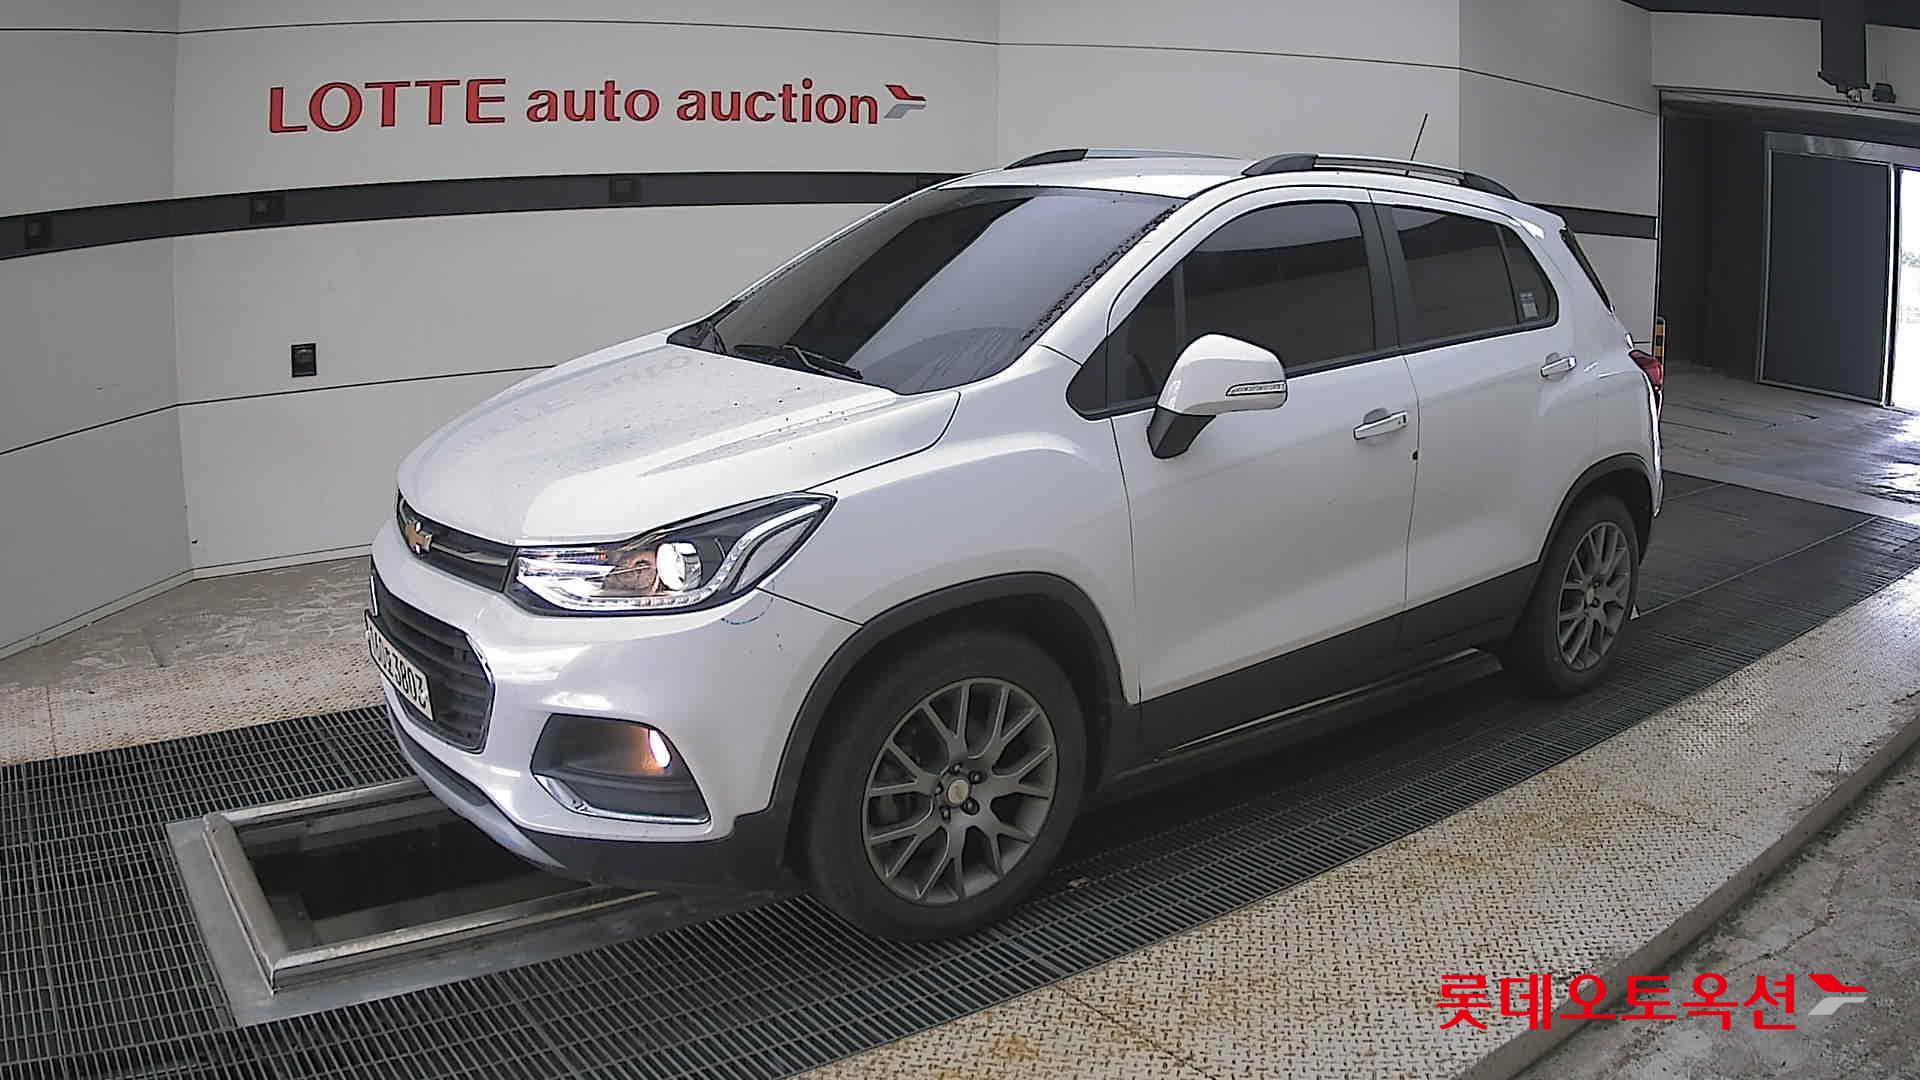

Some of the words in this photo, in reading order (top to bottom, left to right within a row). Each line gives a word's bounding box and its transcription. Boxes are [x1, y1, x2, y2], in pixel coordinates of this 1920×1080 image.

[269, 78, 506, 133] LOTTE
[526, 79, 660, 124] auto
[676, 78, 878, 124] auction
